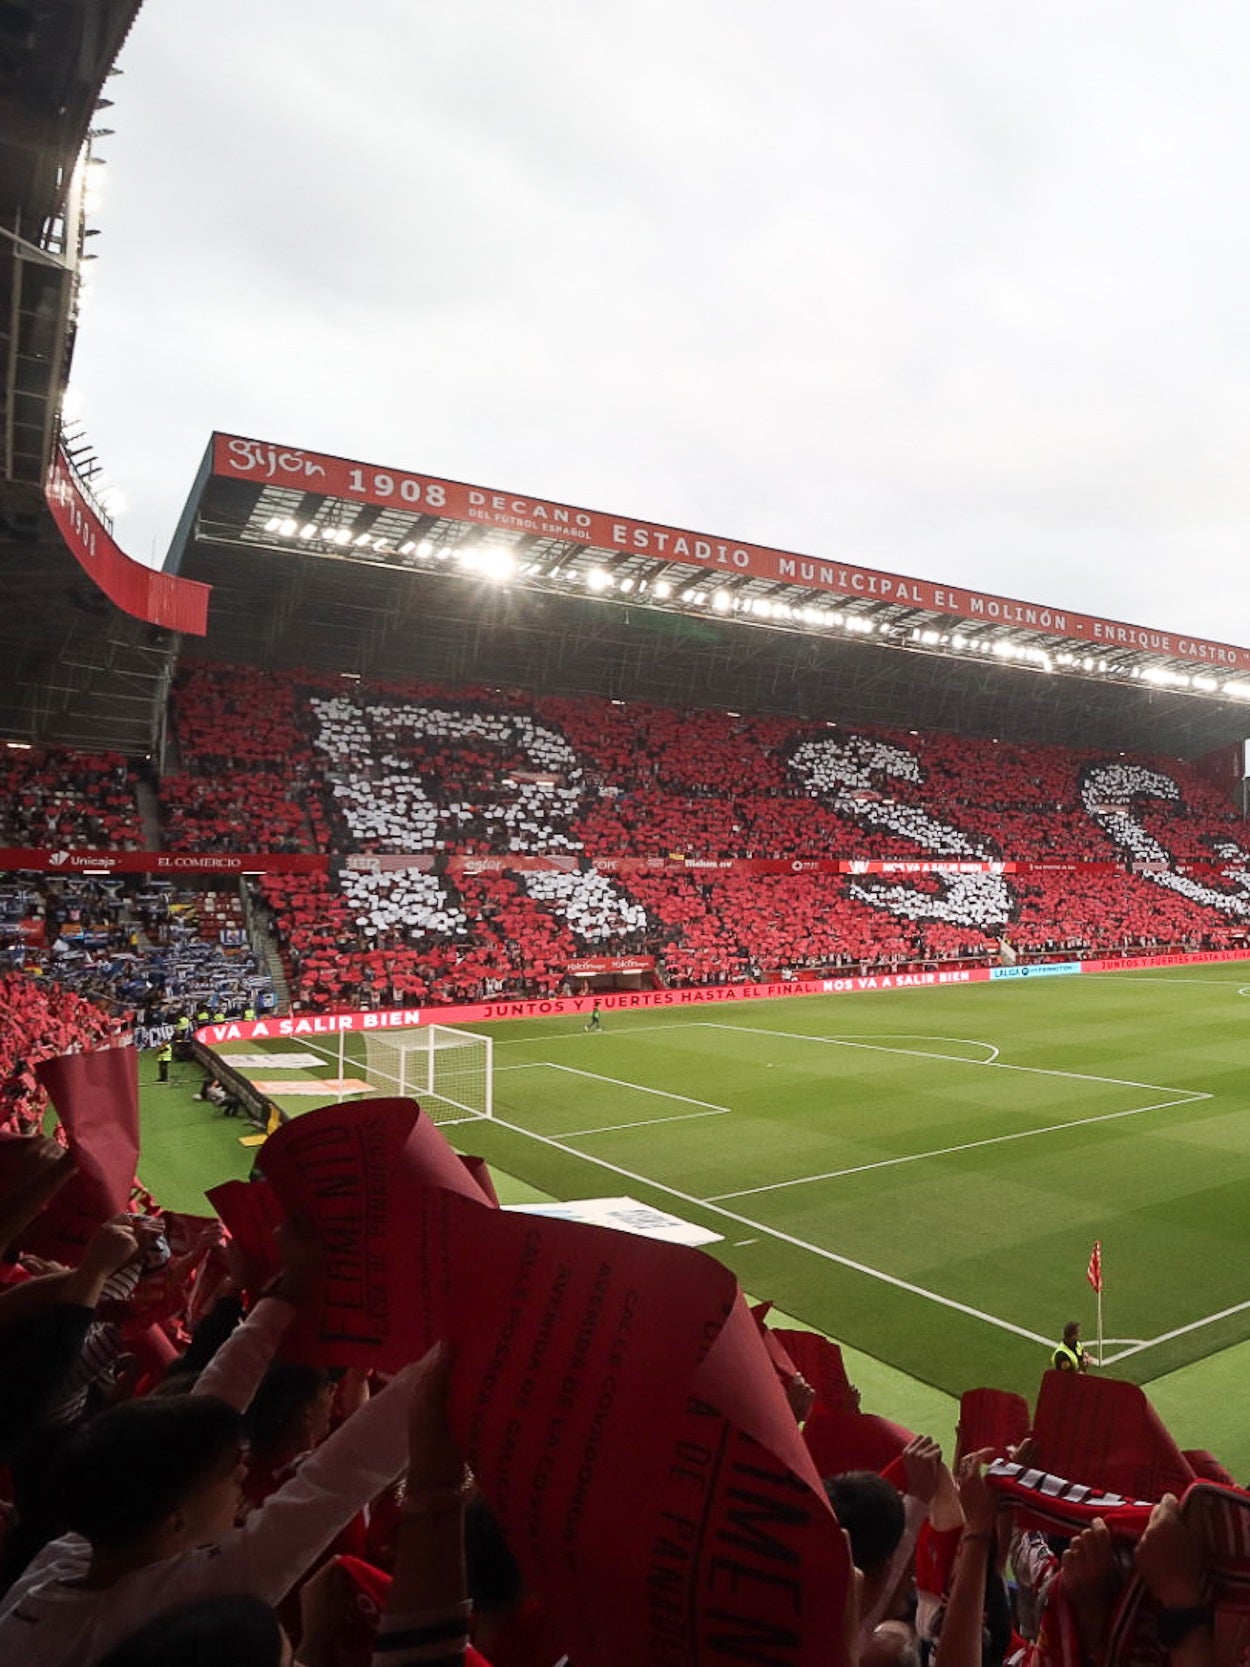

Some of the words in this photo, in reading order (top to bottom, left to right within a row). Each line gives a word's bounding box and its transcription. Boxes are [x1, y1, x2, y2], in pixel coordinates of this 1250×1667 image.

[349, 469, 446, 507] 1908
[468, 491, 592, 527] DECANO
[468, 508, 491, 520] DEL
[542, 522, 593, 540] ESPAÑOL
[612, 524, 750, 568] ESTADIO
[778, 558, 923, 602] MUNICIPAL
[934, 590, 959, 609] EL
[970, 597, 1067, 631] MOLINÓN
[1094, 623, 1170, 650] ENRIQUE
[1178, 640, 1237, 664] CASTRO
[70, 856, 116, 868] Unicaja
[158, 857, 173, 866] EL
[175, 857, 241, 867] COMERCIO
[1101, 959, 1138, 970] JUNTOS
[823, 979, 852, 991] NOS
[857, 978, 876, 988] VA
[882, 976, 891, 986] A
[896, 974, 935, 986] SALIR
[939, 971, 970, 982] BIEN
[483, 1001, 564, 1017] JUNTOS
[574, 999, 585, 1011] Y
[594, 993, 673, 1009] FUERTES
[681, 988, 736, 1003] HASTA
[743, 986, 761, 997] EL
[213, 1025, 241, 1041] VA
[251, 1022, 269, 1036] A
[279, 1015, 353, 1034] SALIR
[363, 1010, 420, 1026] BIEN
[568, 1263, 613, 1369] AVENIDA
[558, 1377, 580, 1408] DE
